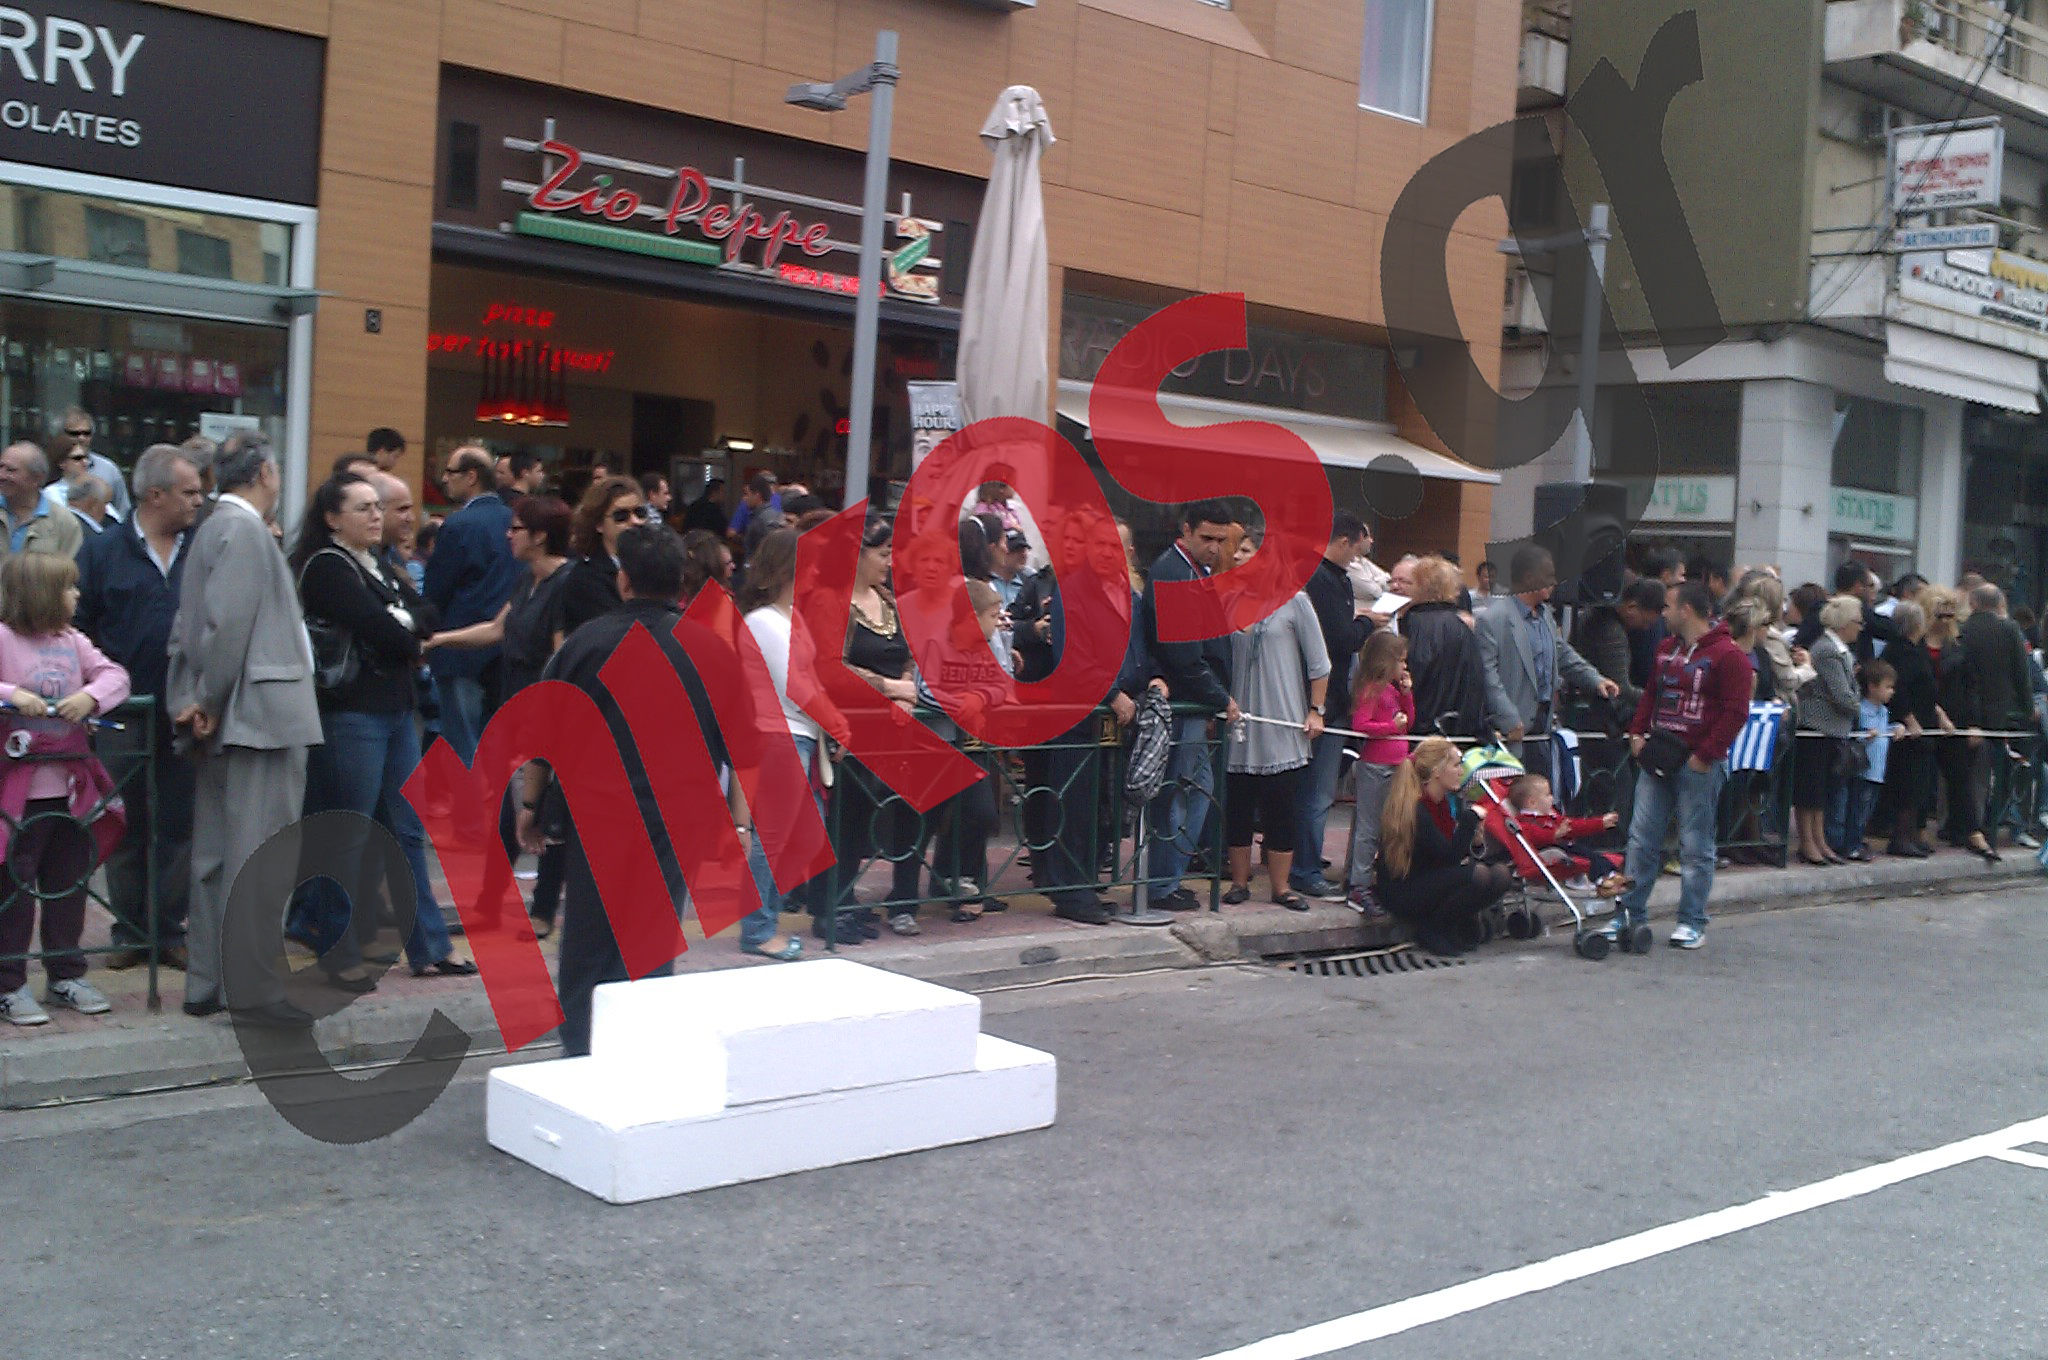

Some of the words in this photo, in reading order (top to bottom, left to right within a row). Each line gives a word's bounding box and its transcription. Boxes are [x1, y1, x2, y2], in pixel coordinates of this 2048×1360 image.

[0, 5, 146, 97] RRY
[0, 99, 142, 147] OLATES
[530, 139, 641, 221] Zio
[653, 165, 834, 269] Peppe
[1836, 493, 1895, 524] STATUS
